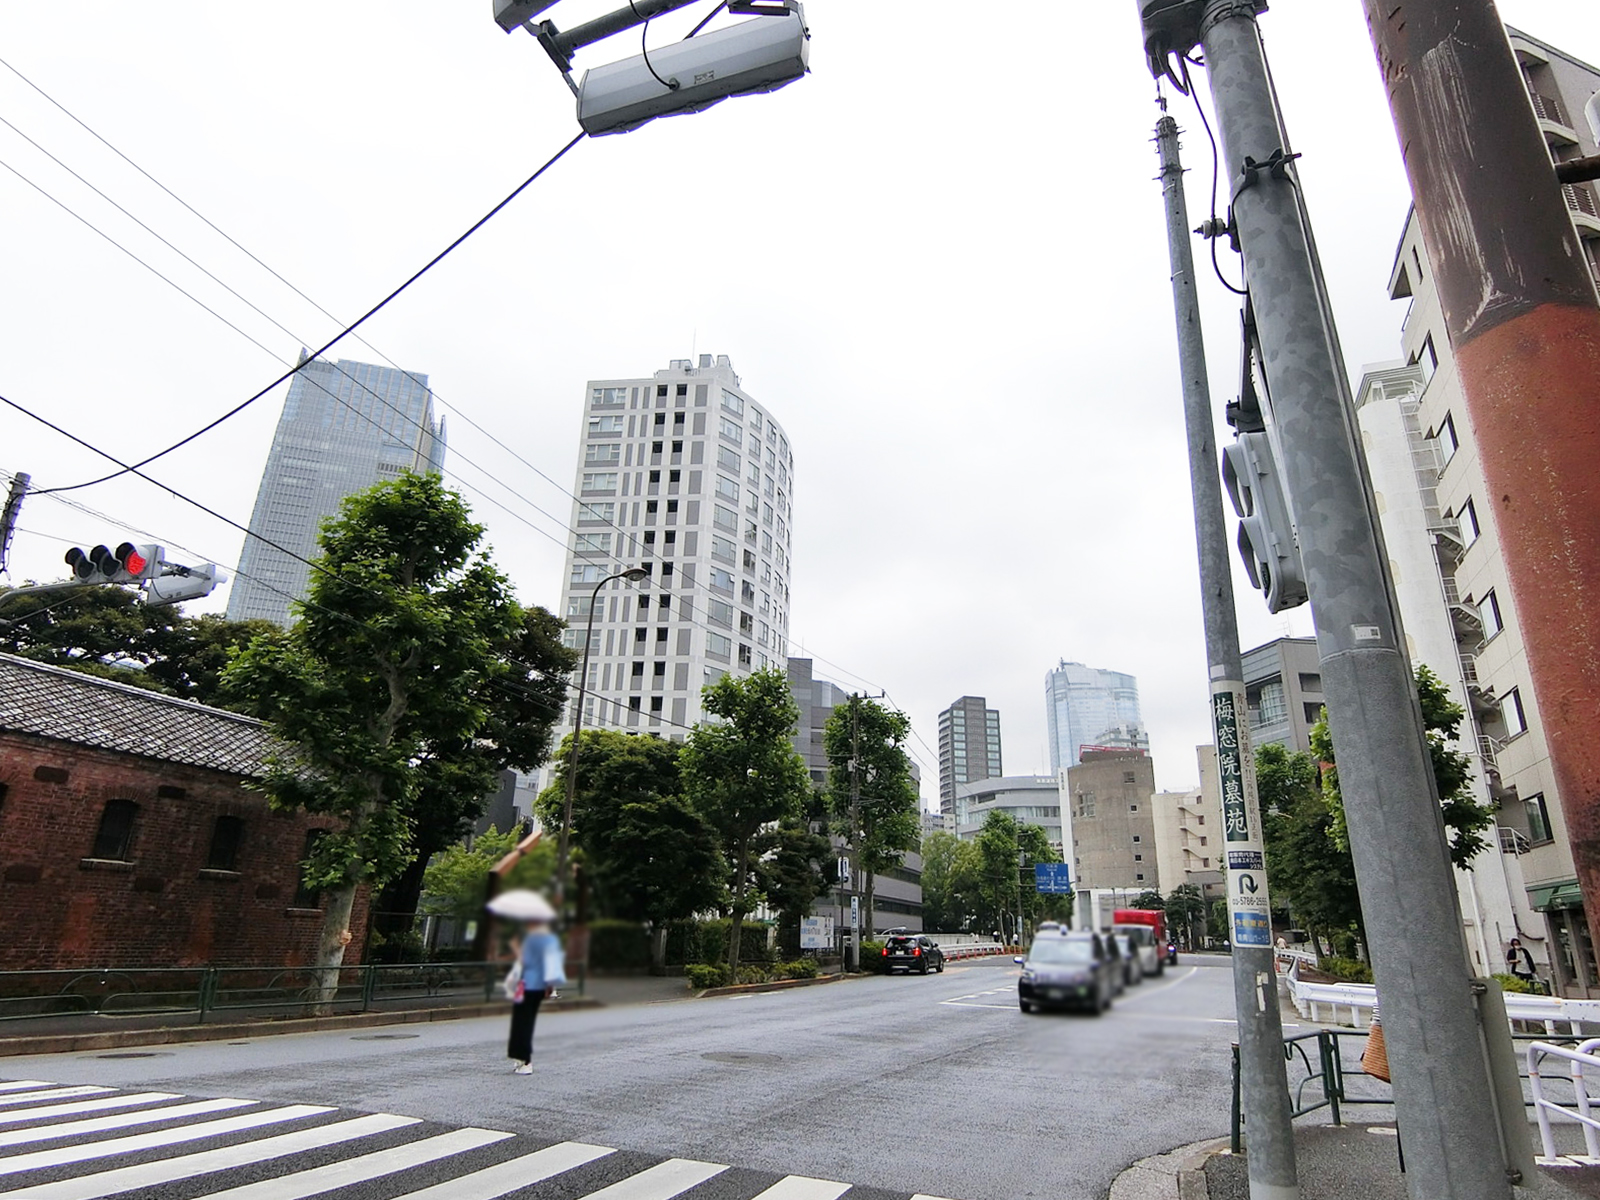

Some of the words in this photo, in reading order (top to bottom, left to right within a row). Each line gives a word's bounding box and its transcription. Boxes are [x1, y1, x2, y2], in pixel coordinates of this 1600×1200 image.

[1215, 697, 1248, 835] 梅窓院墓苑
